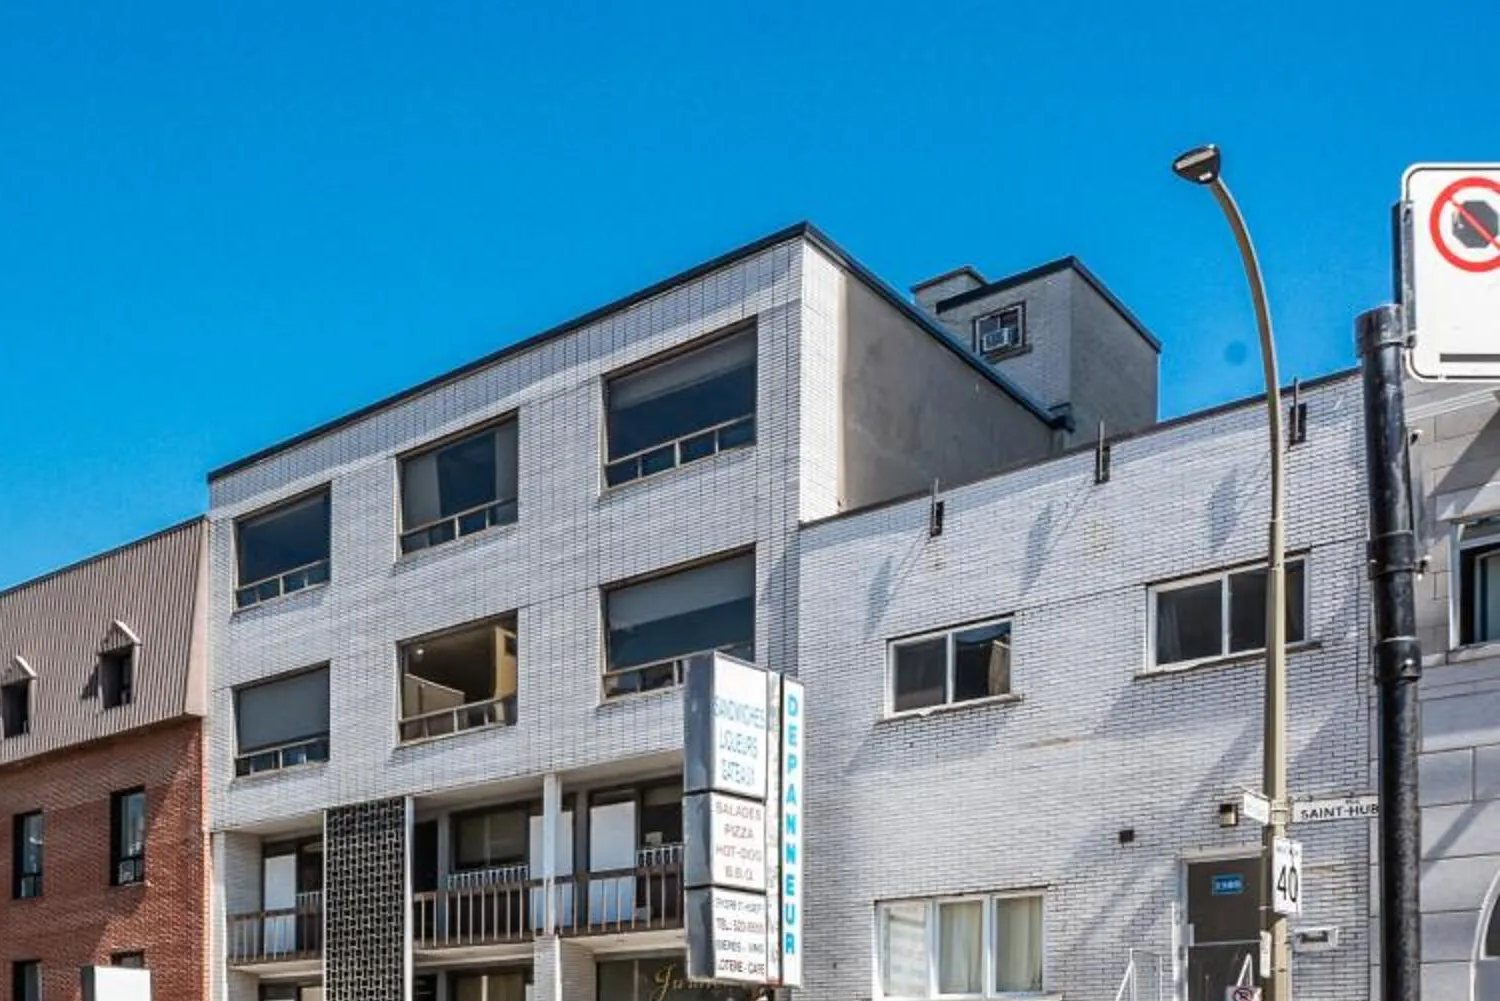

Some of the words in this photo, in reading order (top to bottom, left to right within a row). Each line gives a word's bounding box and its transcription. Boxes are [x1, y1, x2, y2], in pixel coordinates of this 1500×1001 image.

[724, 823, 754, 839] PIZZA
[785, 693, 799, 955] DEPANNEUR
[1276, 864, 1299, 903] 40
